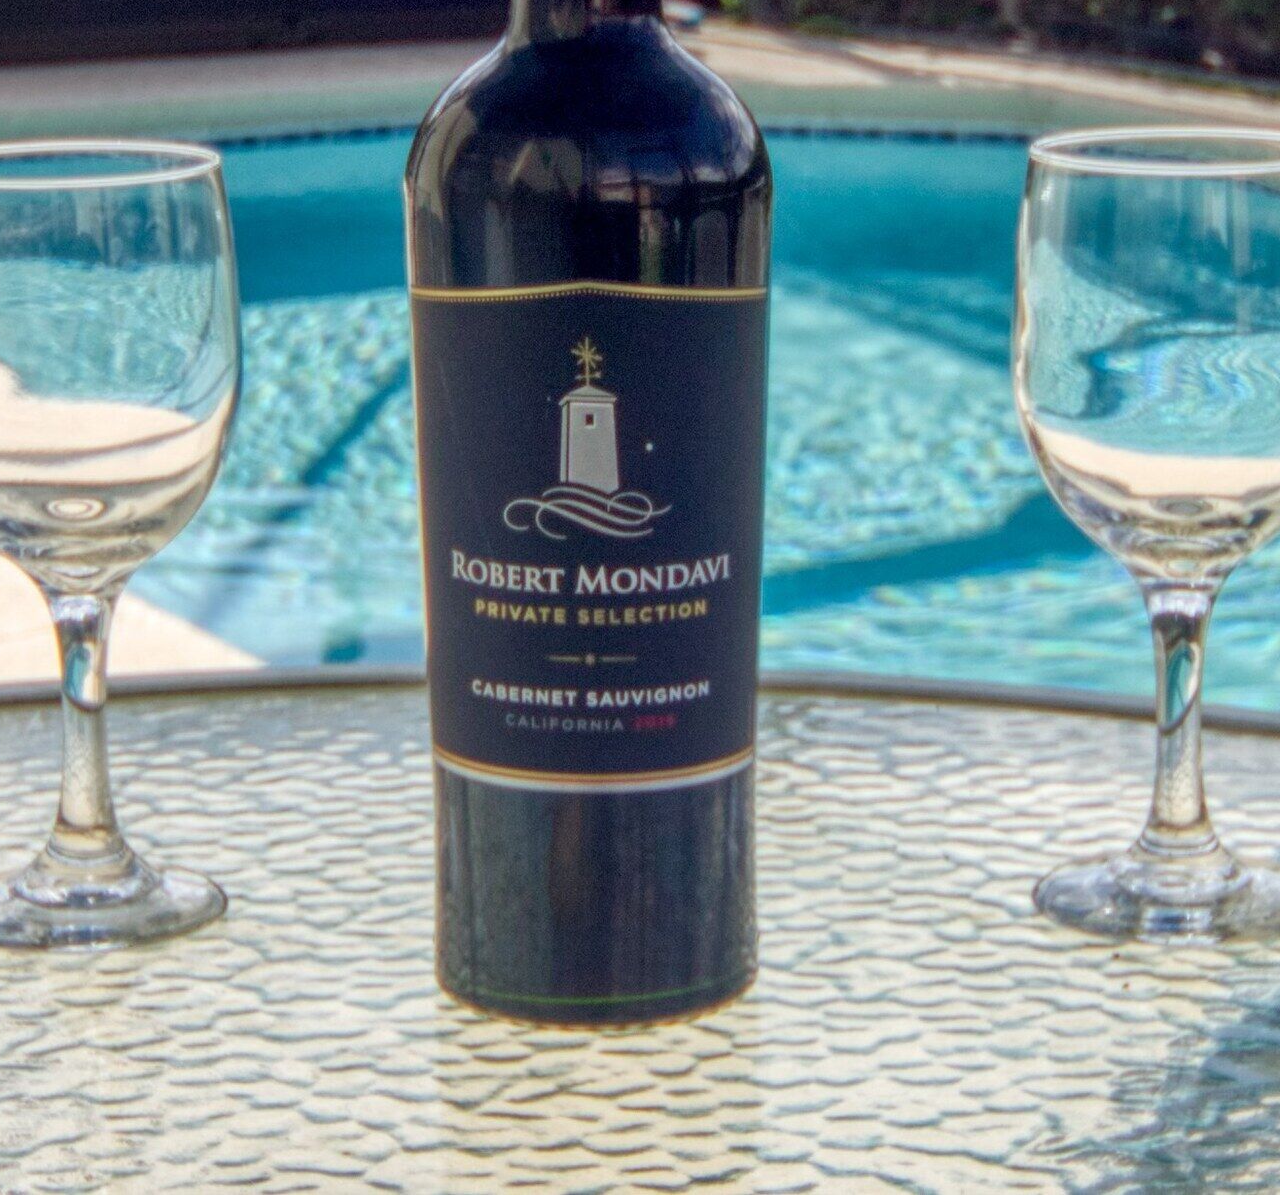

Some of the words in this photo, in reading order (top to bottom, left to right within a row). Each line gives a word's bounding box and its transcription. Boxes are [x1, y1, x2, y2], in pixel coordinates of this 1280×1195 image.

[475, 599, 567, 624] PRIVATE
[577, 600, 708, 625] SELECTION
[471, 679, 577, 706] CABERNET
[586, 680, 710, 707] SAUVIGNON
[505, 713, 624, 732] CALIFORNIA
